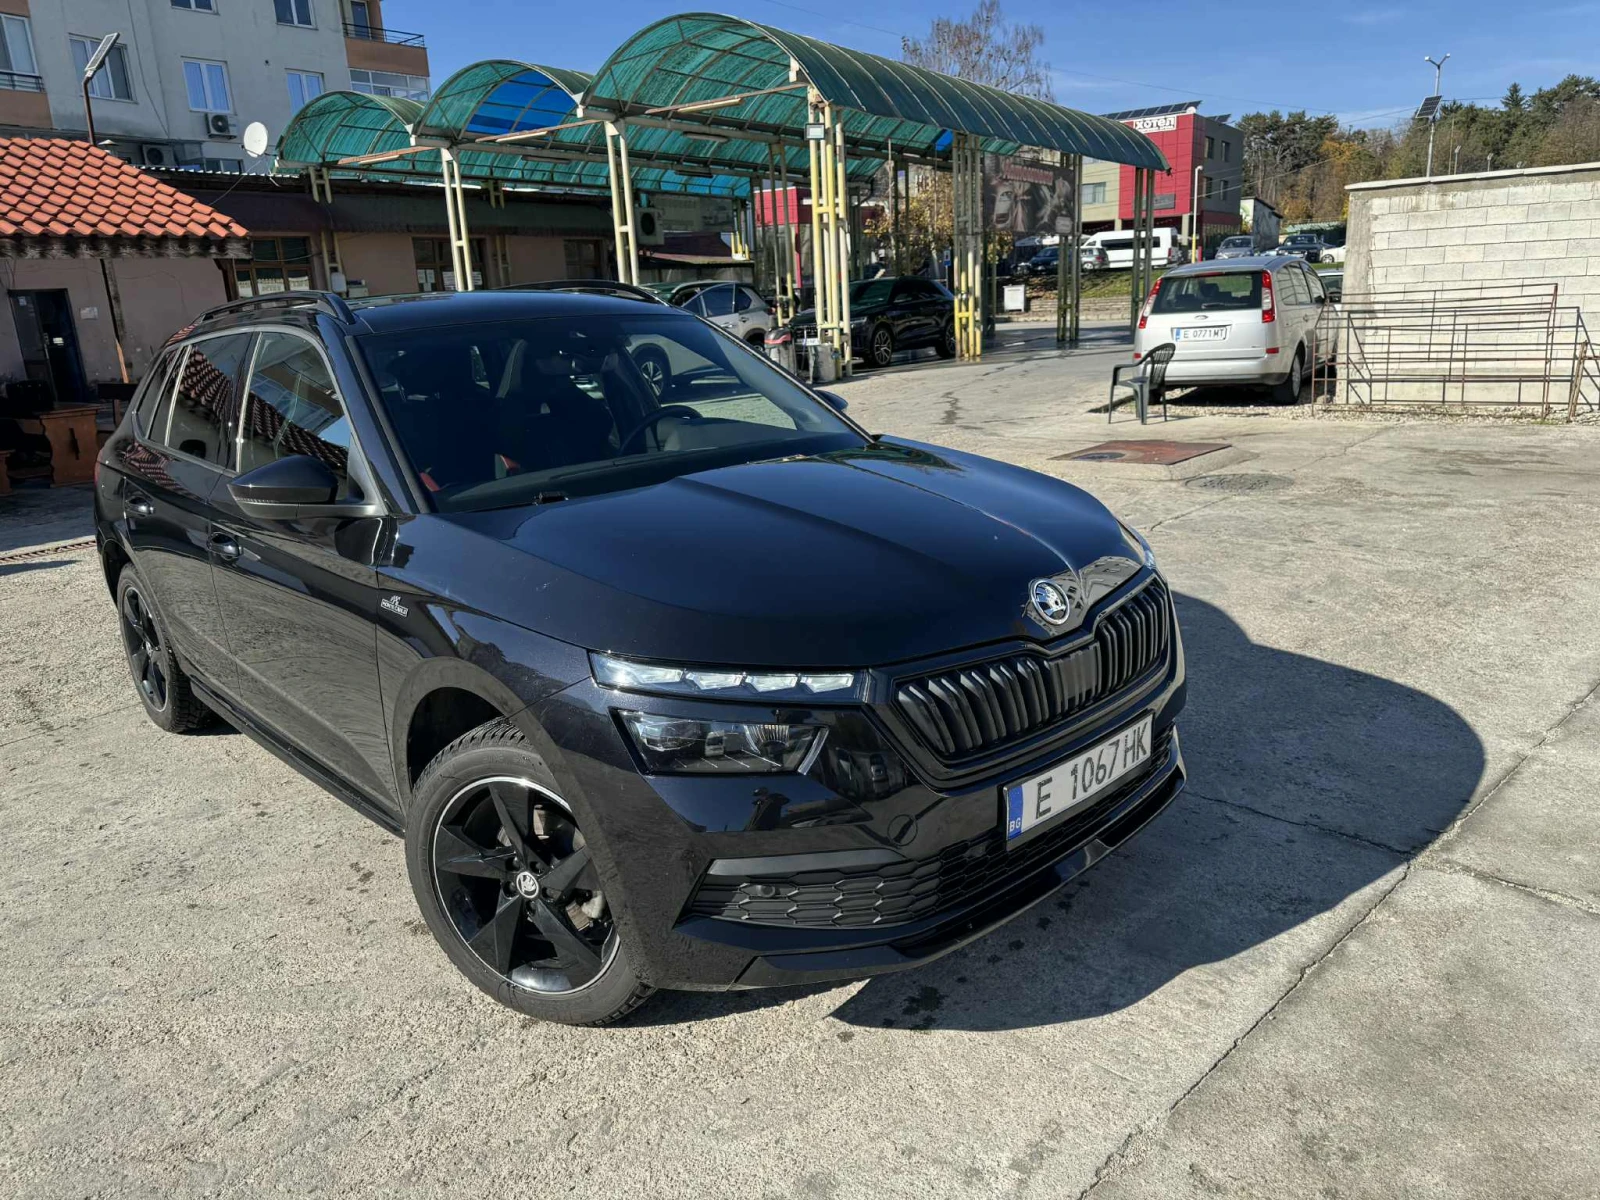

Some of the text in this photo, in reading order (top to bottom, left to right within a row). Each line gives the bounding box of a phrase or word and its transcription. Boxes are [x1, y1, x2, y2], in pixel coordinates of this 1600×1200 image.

[1183, 330, 1189, 339] E
[1035, 776, 1053, 820] E
[1009, 817, 1022, 832] BG
